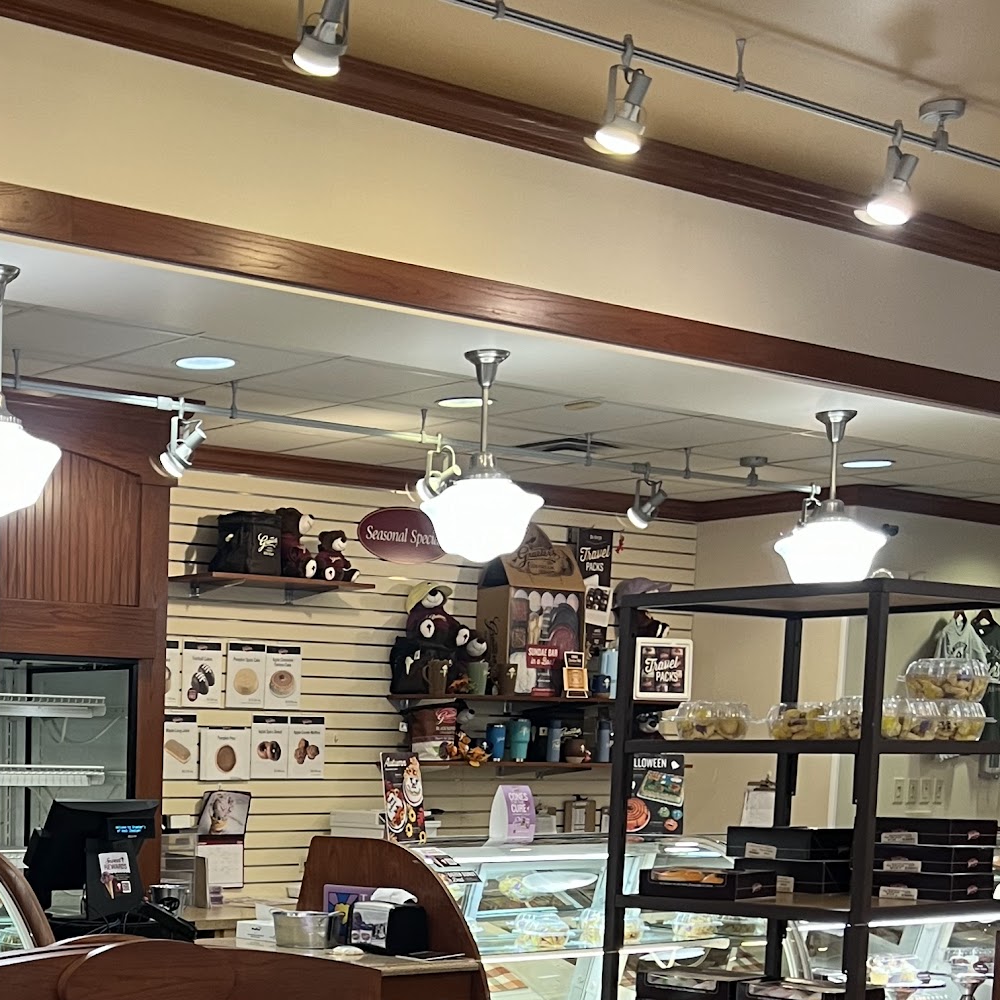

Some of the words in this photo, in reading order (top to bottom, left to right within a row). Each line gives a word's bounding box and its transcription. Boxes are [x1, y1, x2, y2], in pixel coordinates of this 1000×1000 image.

[365, 525, 409, 543] Seasonal
[579, 545, 611, 562] Travel
[585, 562, 604, 572] PACKS
[528, 647, 548, 657] SUNDAE
[548, 648, 558, 657] BAR
[645, 656, 682, 673] Travel
[655, 671, 678, 682] PACKS
[633, 757, 668, 768] LLOWEEN
